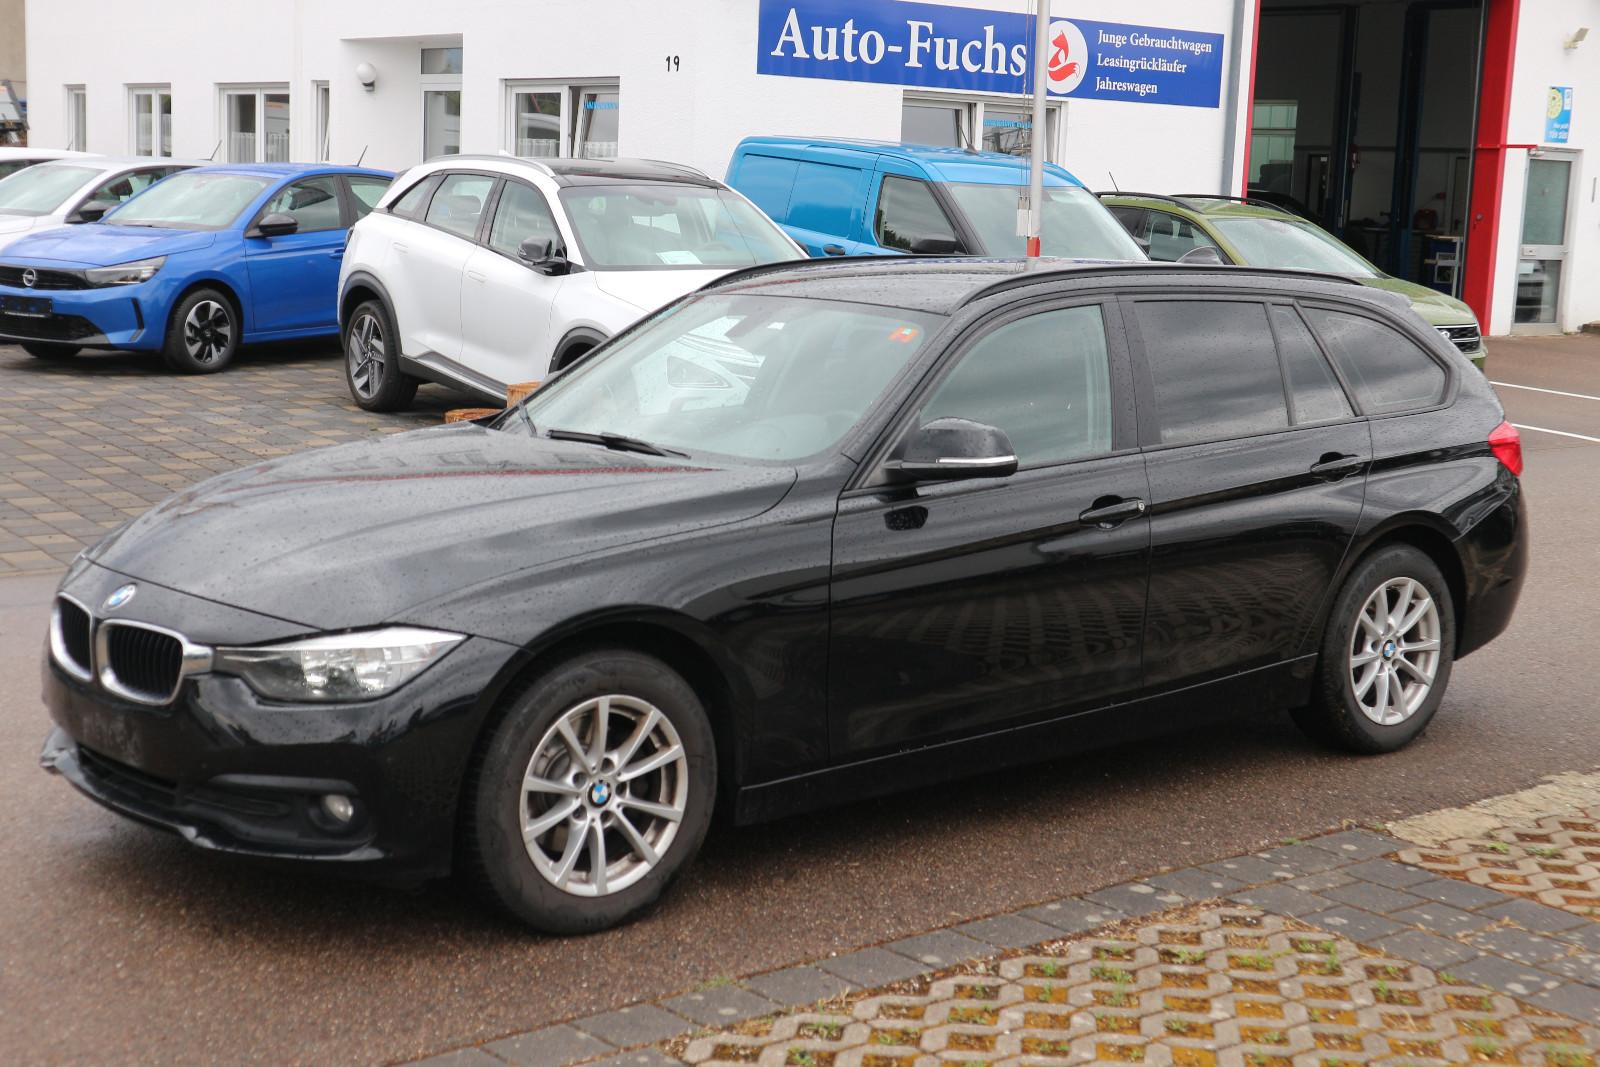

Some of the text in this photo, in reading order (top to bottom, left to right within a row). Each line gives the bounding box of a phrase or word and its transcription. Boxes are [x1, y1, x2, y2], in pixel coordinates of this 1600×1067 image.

[770, 7, 1027, 77] Auto-Fuchs
[1098, 29, 1212, 55] Junge Gebrauchtwagen
[665, 55, 680, 73] 19
[1097, 53, 1187, 72] Leasingrückläufer
[1095, 76, 1158, 96] Jahreswagen
